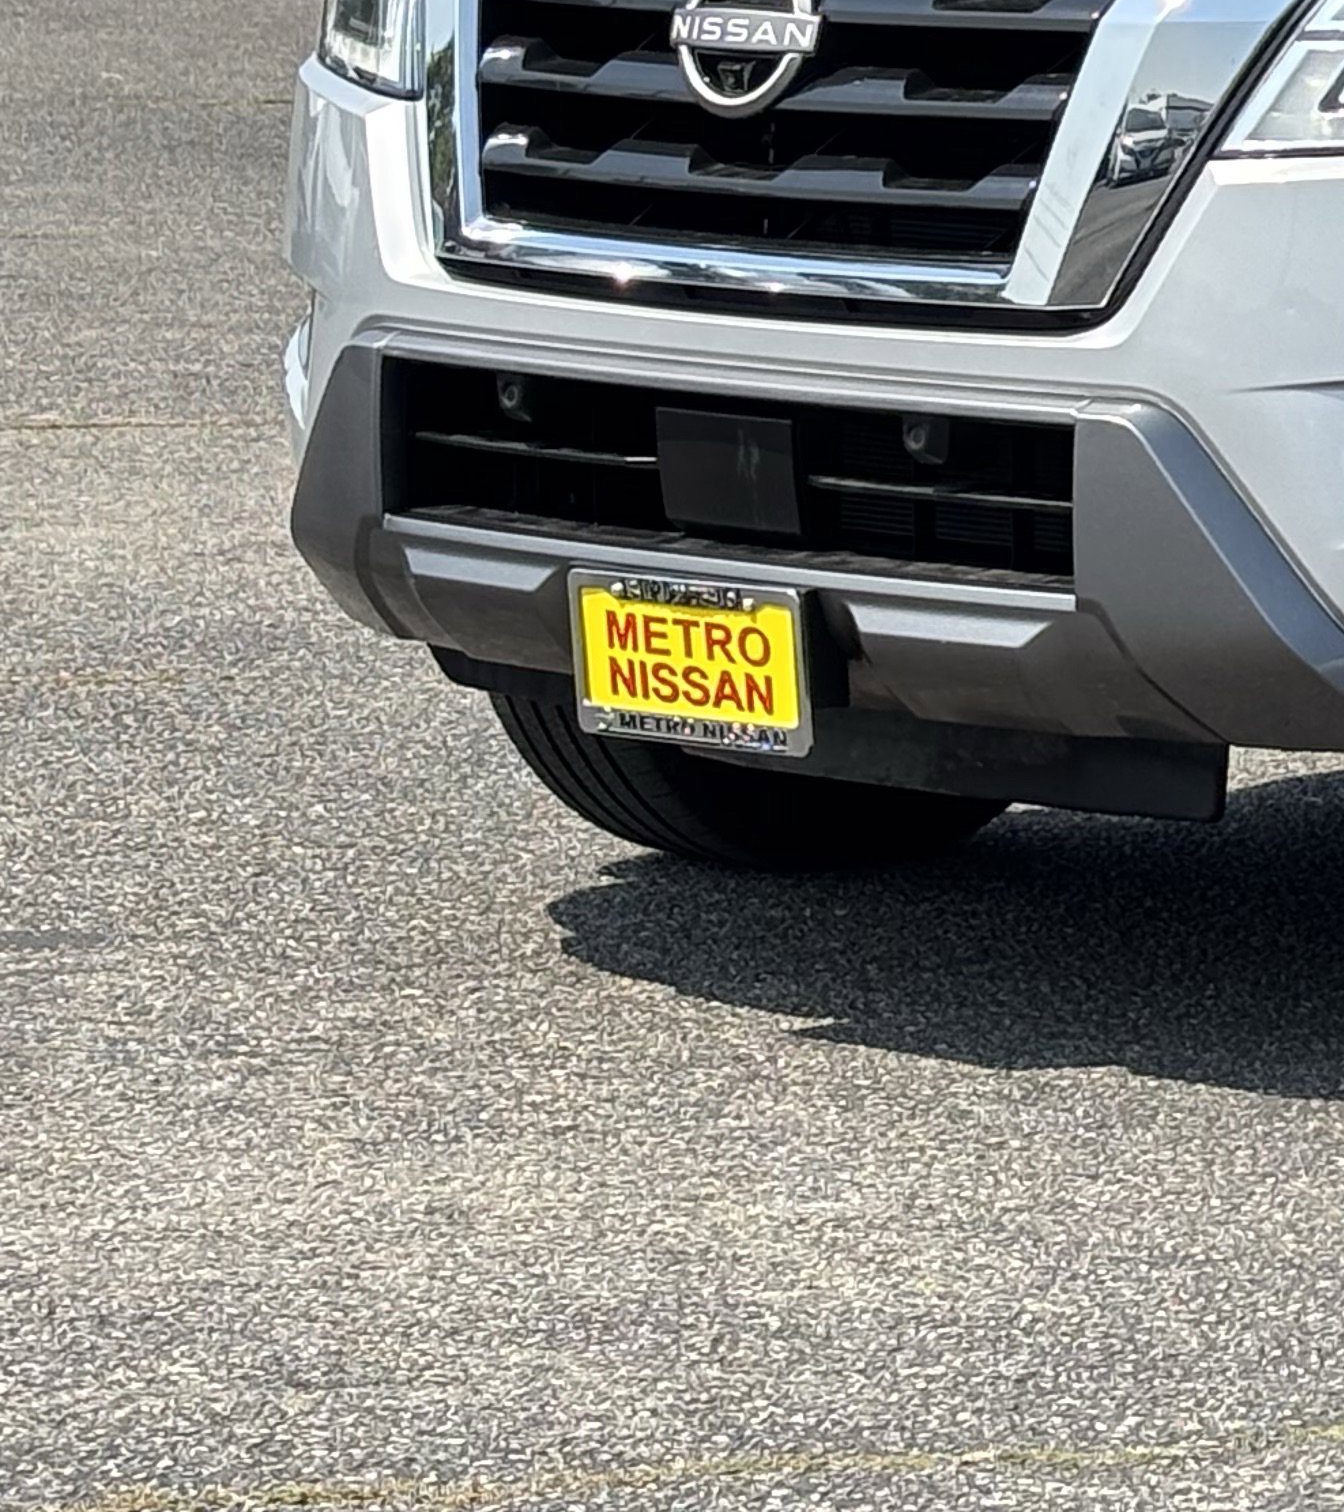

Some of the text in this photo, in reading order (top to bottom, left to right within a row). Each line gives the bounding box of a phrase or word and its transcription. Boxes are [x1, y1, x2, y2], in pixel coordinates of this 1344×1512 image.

[670, 14, 815, 48] NISSAN
[605, 608, 771, 668] METRO
[608, 655, 775, 717] NISSAN
[619, 713, 788, 748] METRO NISSAN
